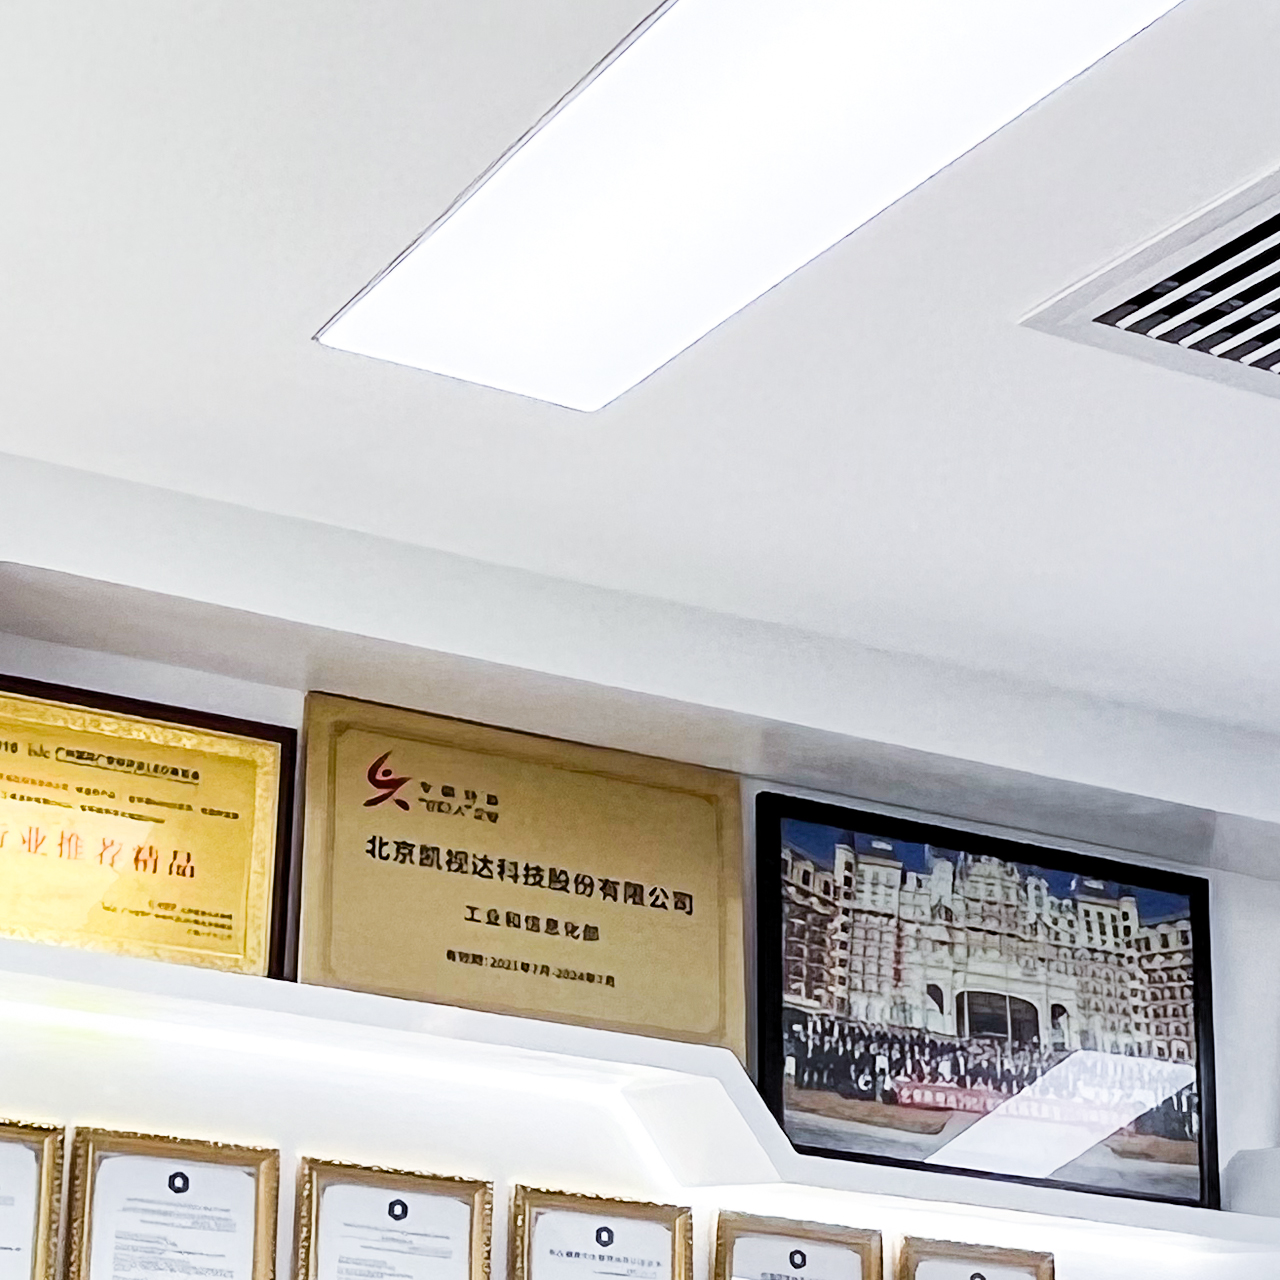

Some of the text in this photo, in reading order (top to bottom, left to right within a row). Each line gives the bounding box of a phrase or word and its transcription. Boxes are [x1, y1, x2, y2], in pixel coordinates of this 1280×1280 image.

[365, 835, 694, 916] 北京凯视达科技股份有限公司
